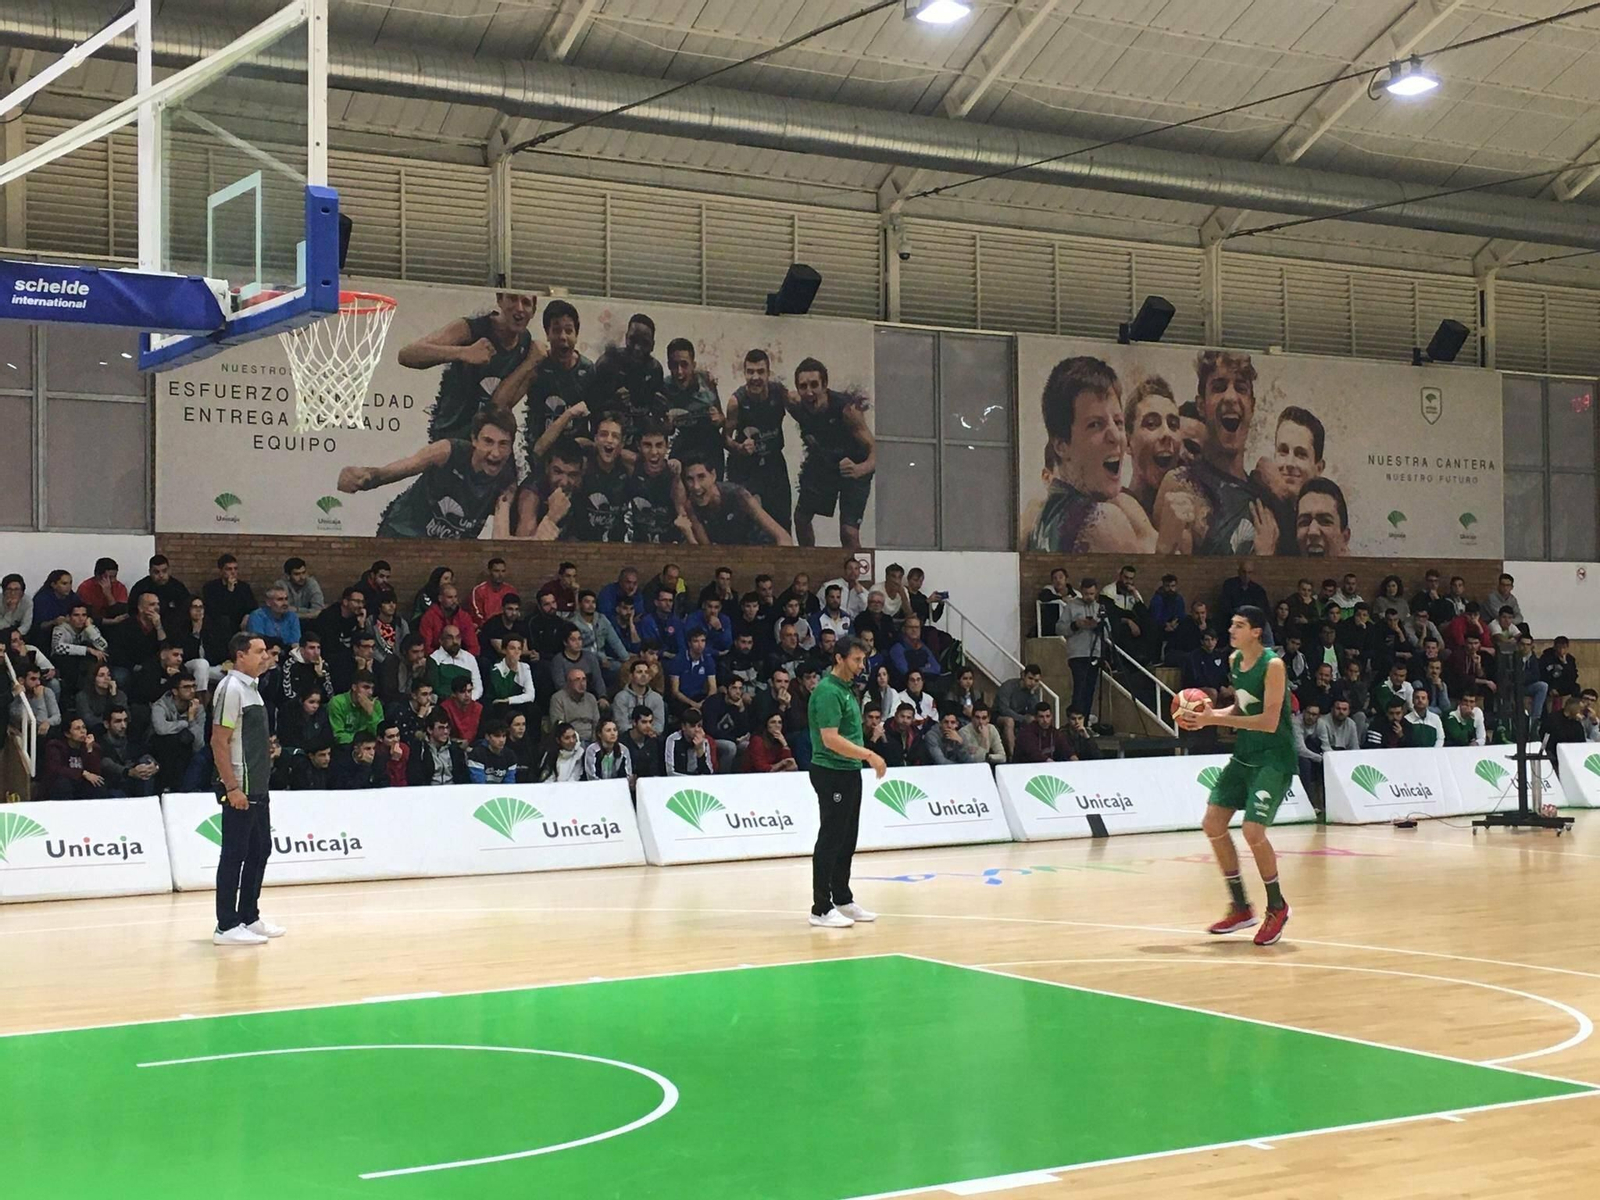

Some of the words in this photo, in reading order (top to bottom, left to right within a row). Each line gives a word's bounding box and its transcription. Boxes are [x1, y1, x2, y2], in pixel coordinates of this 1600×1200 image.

[14, 278, 90, 297] schelde
[11, 294, 87, 309] international
[169, 381, 290, 403] ESFUERZO
[184, 407, 290, 427] ENTREGA
[253, 434, 338, 454] EQUIPO
[1367, 454, 1429, 468] NUESTRA
[1436, 457, 1496, 471] CANTERA
[1386, 473, 1433, 484] NUESTRO
[1439, 475, 1479, 485] FUTURO
[1390, 782, 1433, 799] Unicaja
[928, 797, 990, 818] Unicaja
[1075, 792, 1134, 811] Unicaja
[542, 817, 622, 839] Unicaja
[726, 809, 794, 830] Unicaja
[46, 835, 144, 861] Unicaja
[274, 833, 363, 856] Unicaja
